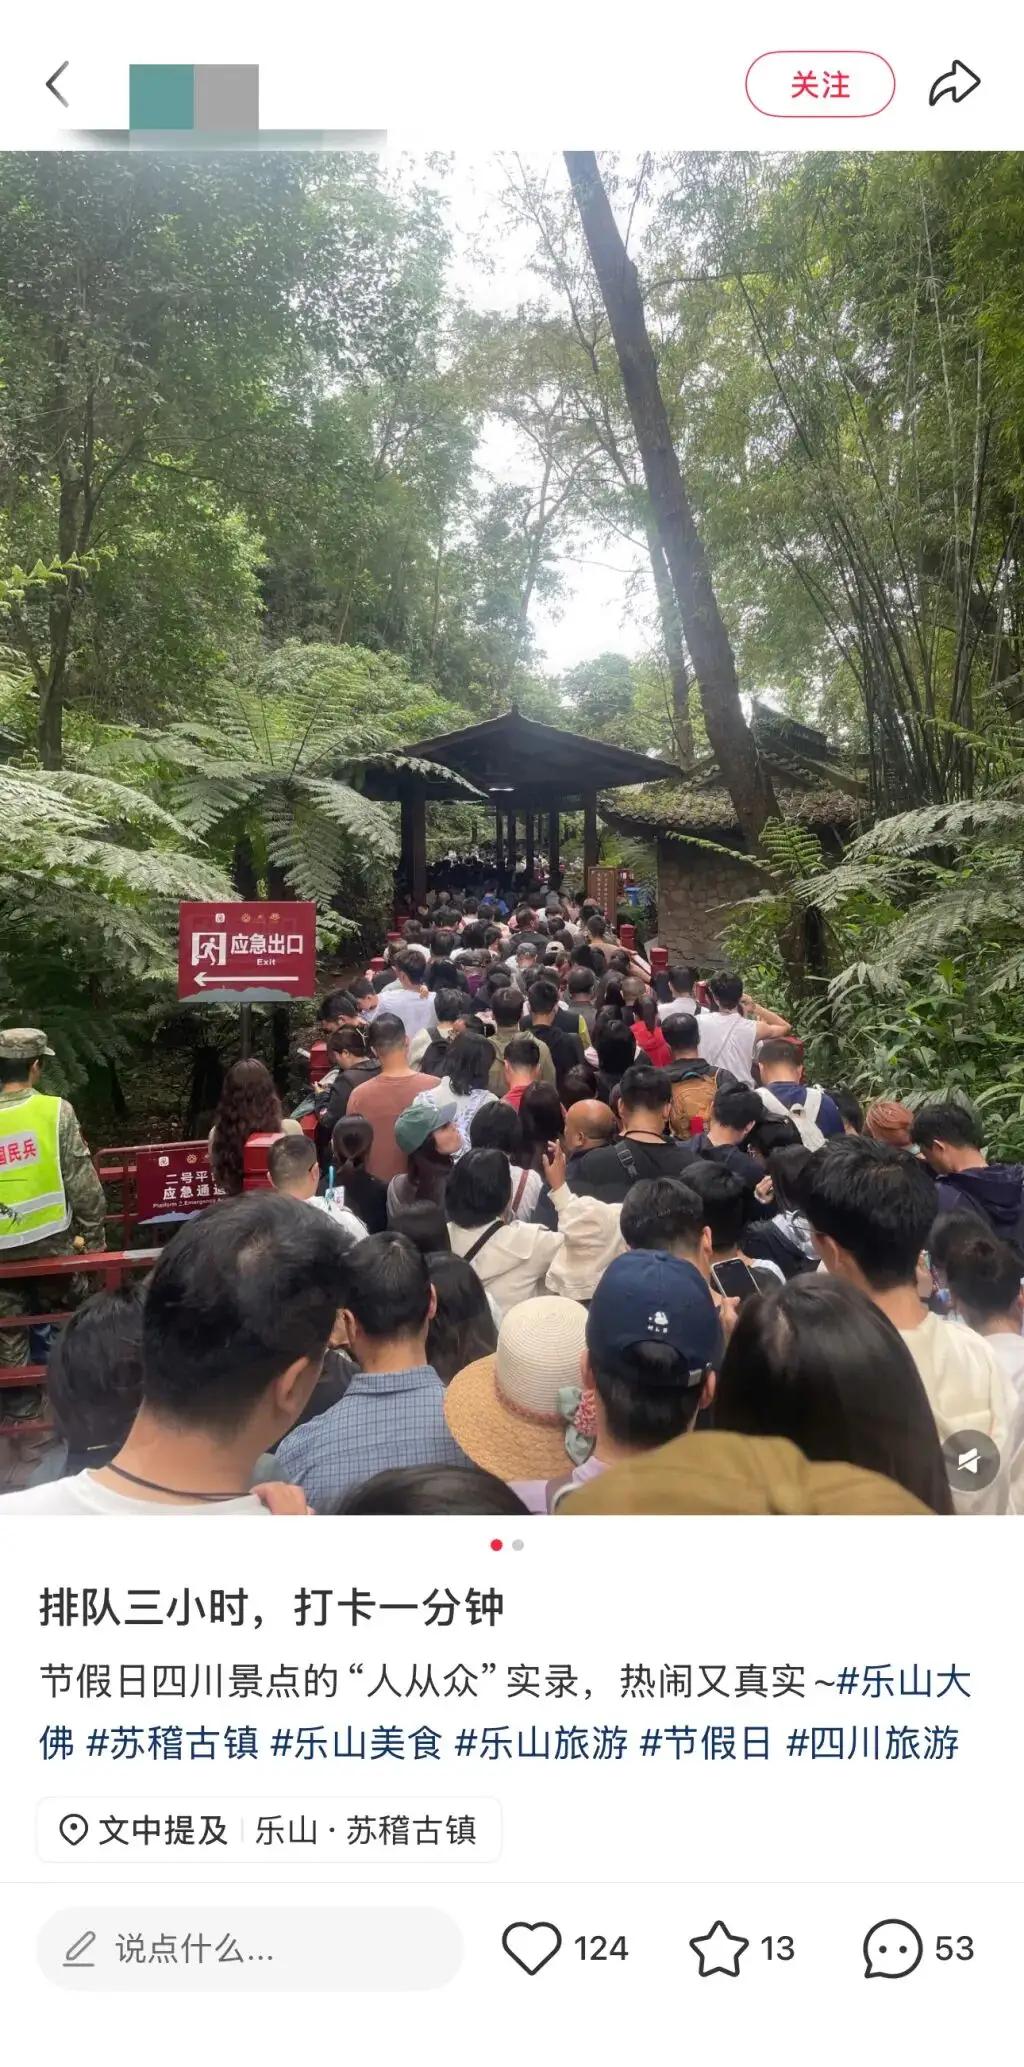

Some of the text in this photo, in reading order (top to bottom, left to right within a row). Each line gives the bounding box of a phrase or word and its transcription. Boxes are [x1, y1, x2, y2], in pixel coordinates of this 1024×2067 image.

[231, 933, 303, 954] 应急出口
[256, 958, 276, 966] Exit
[165, 1170, 216, 1185] 二号平
